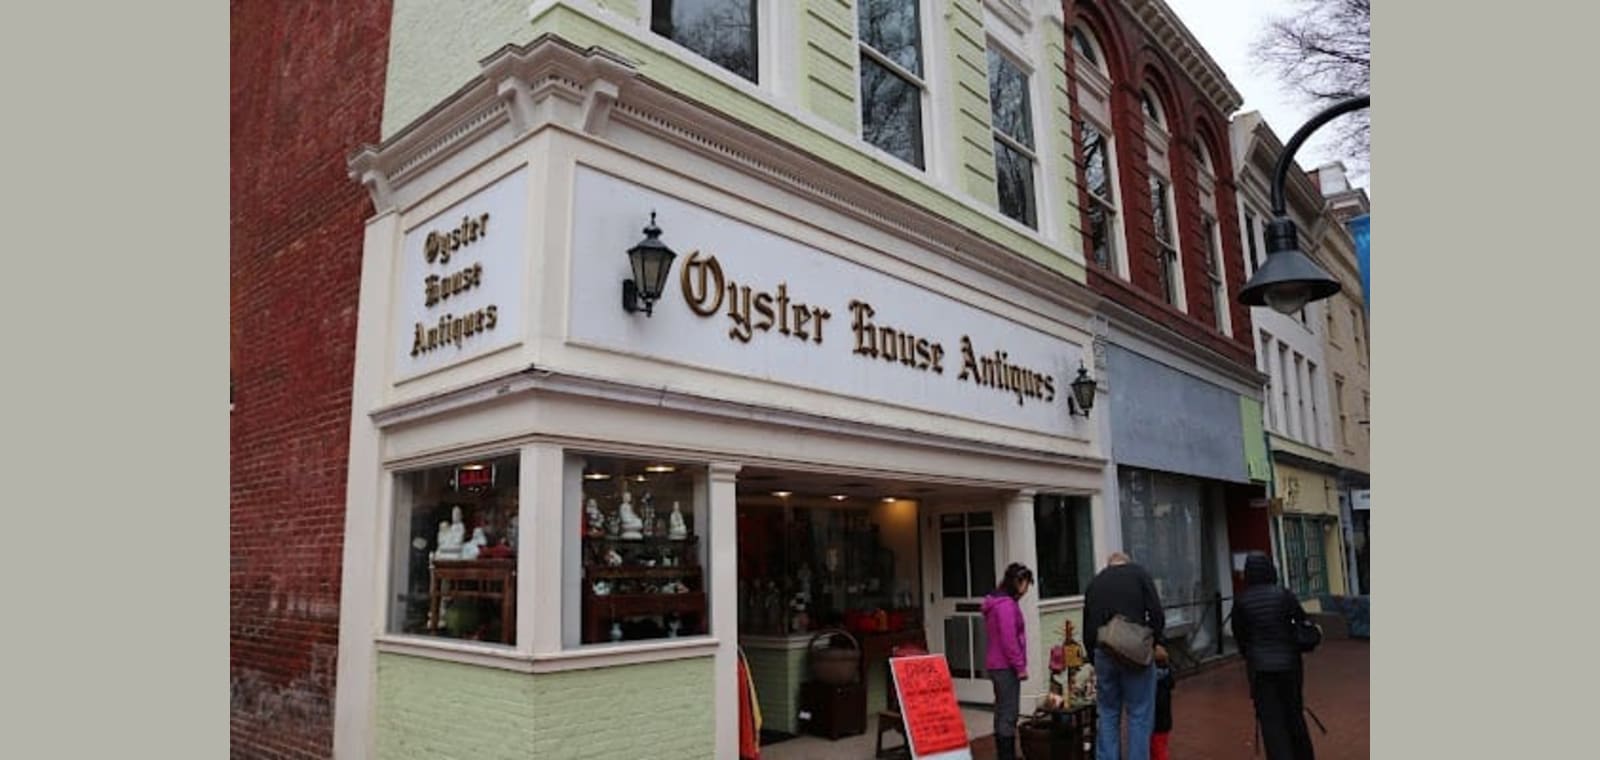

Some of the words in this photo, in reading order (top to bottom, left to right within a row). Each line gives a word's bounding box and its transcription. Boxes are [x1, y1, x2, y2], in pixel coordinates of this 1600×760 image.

[424, 213, 489, 263] Oyster
[424, 262, 482, 308] House
[411, 305, 497, 356] Antiques
[680, 250, 830, 344] Oyster
[849, 299, 945, 375] House
[958, 334, 1055, 407] Antiques
